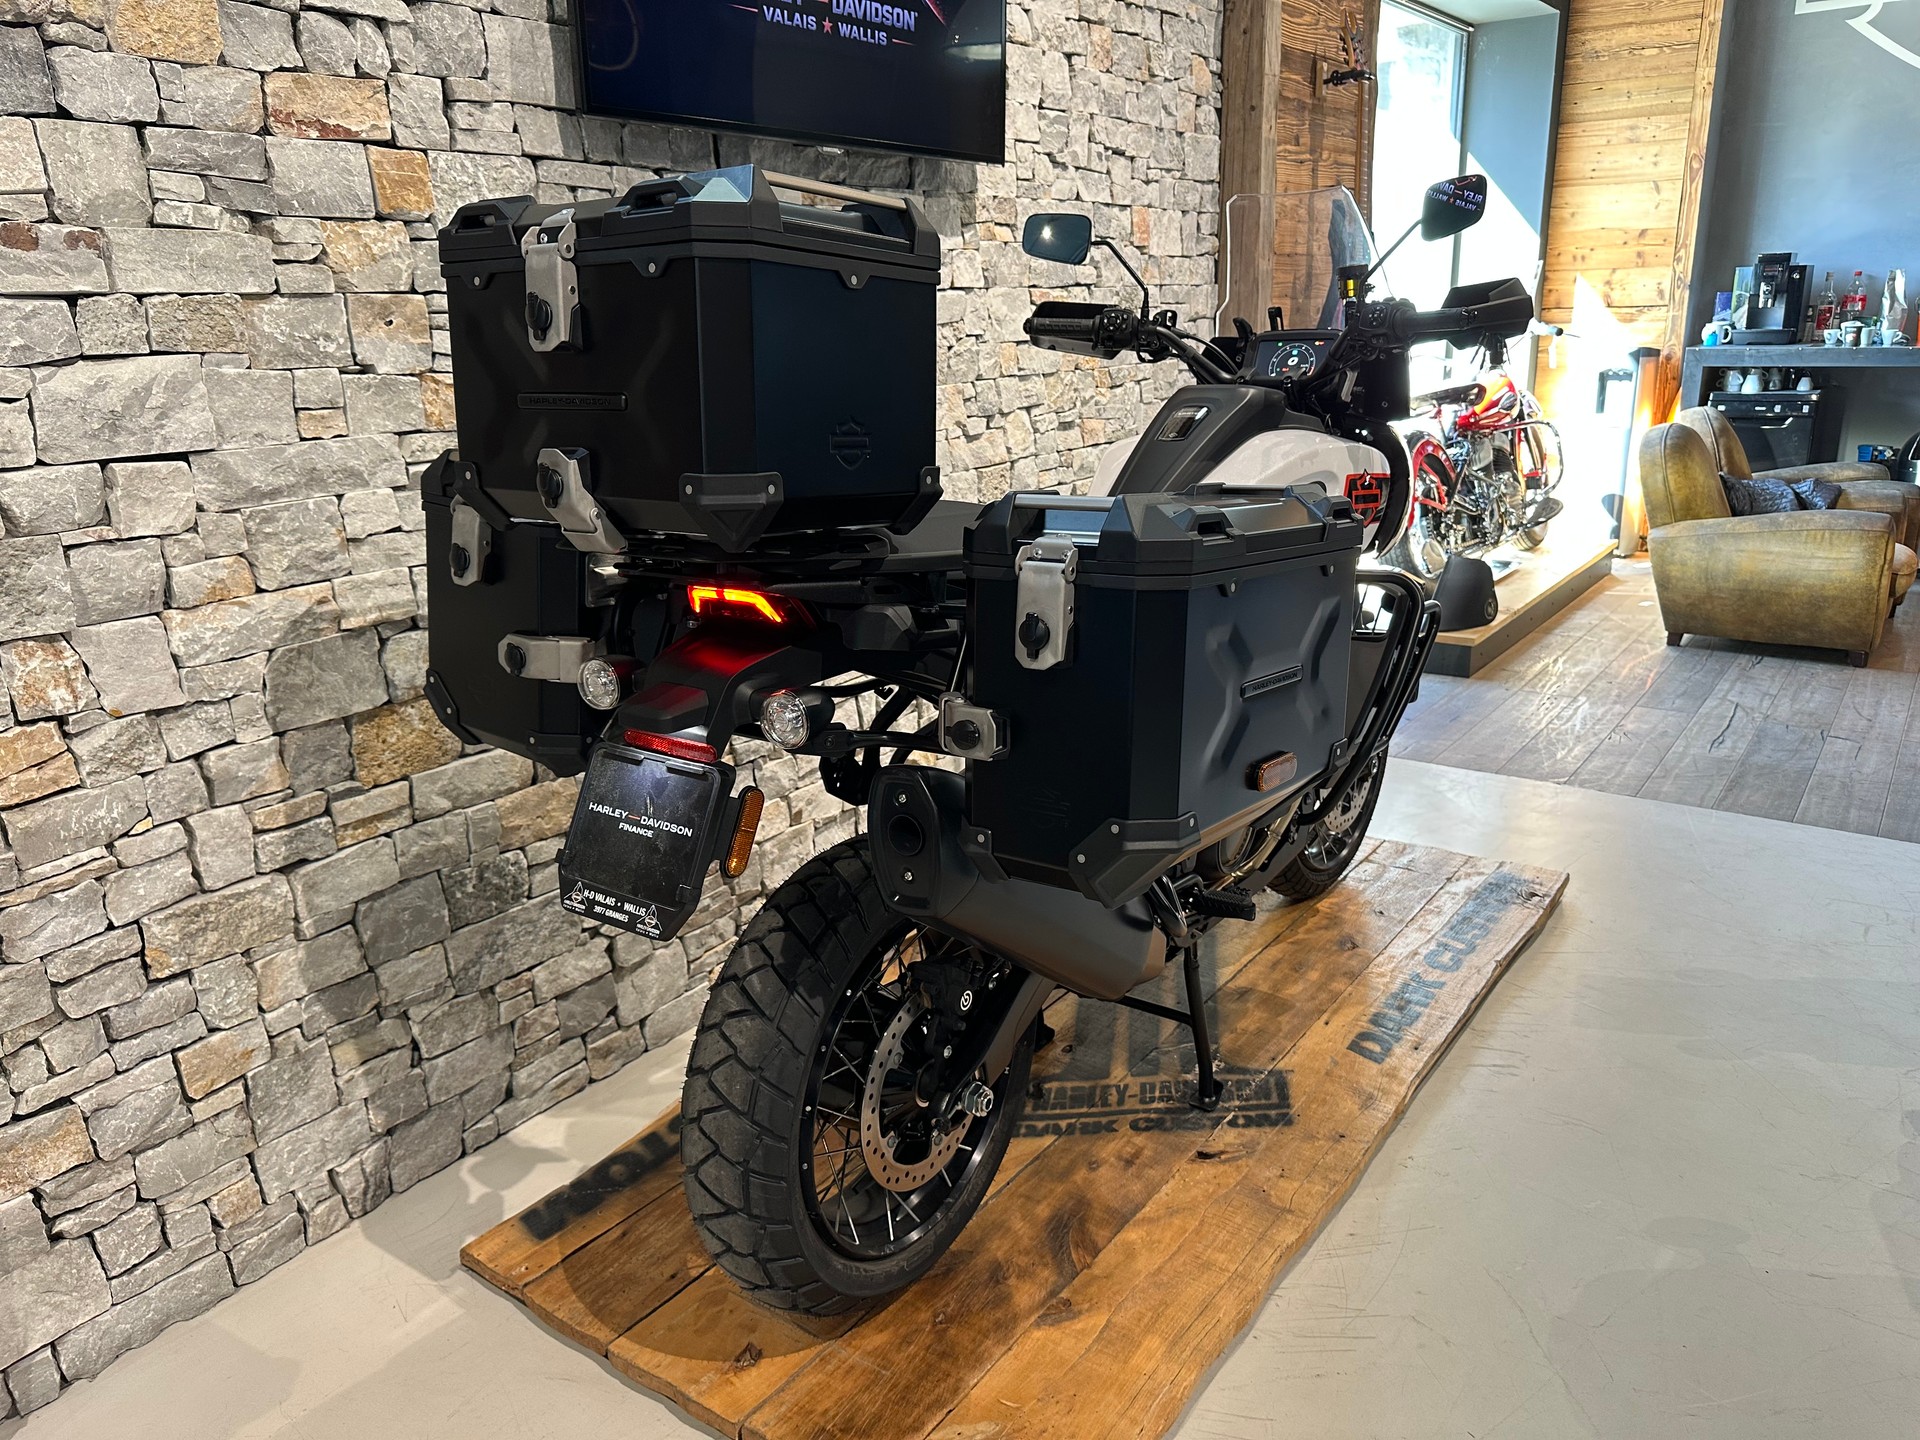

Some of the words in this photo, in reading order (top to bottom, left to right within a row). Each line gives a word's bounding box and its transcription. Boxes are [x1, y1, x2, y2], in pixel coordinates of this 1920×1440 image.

[763, 5, 817, 31] VALAIS
[838, 21, 888, 46] WALLIS
[618, 822, 654, 838] FINANCE
[595, 892, 617, 907] VALAIS
[623, 902, 647, 916] WALLIS
[605, 908, 629, 923] GRANGES
